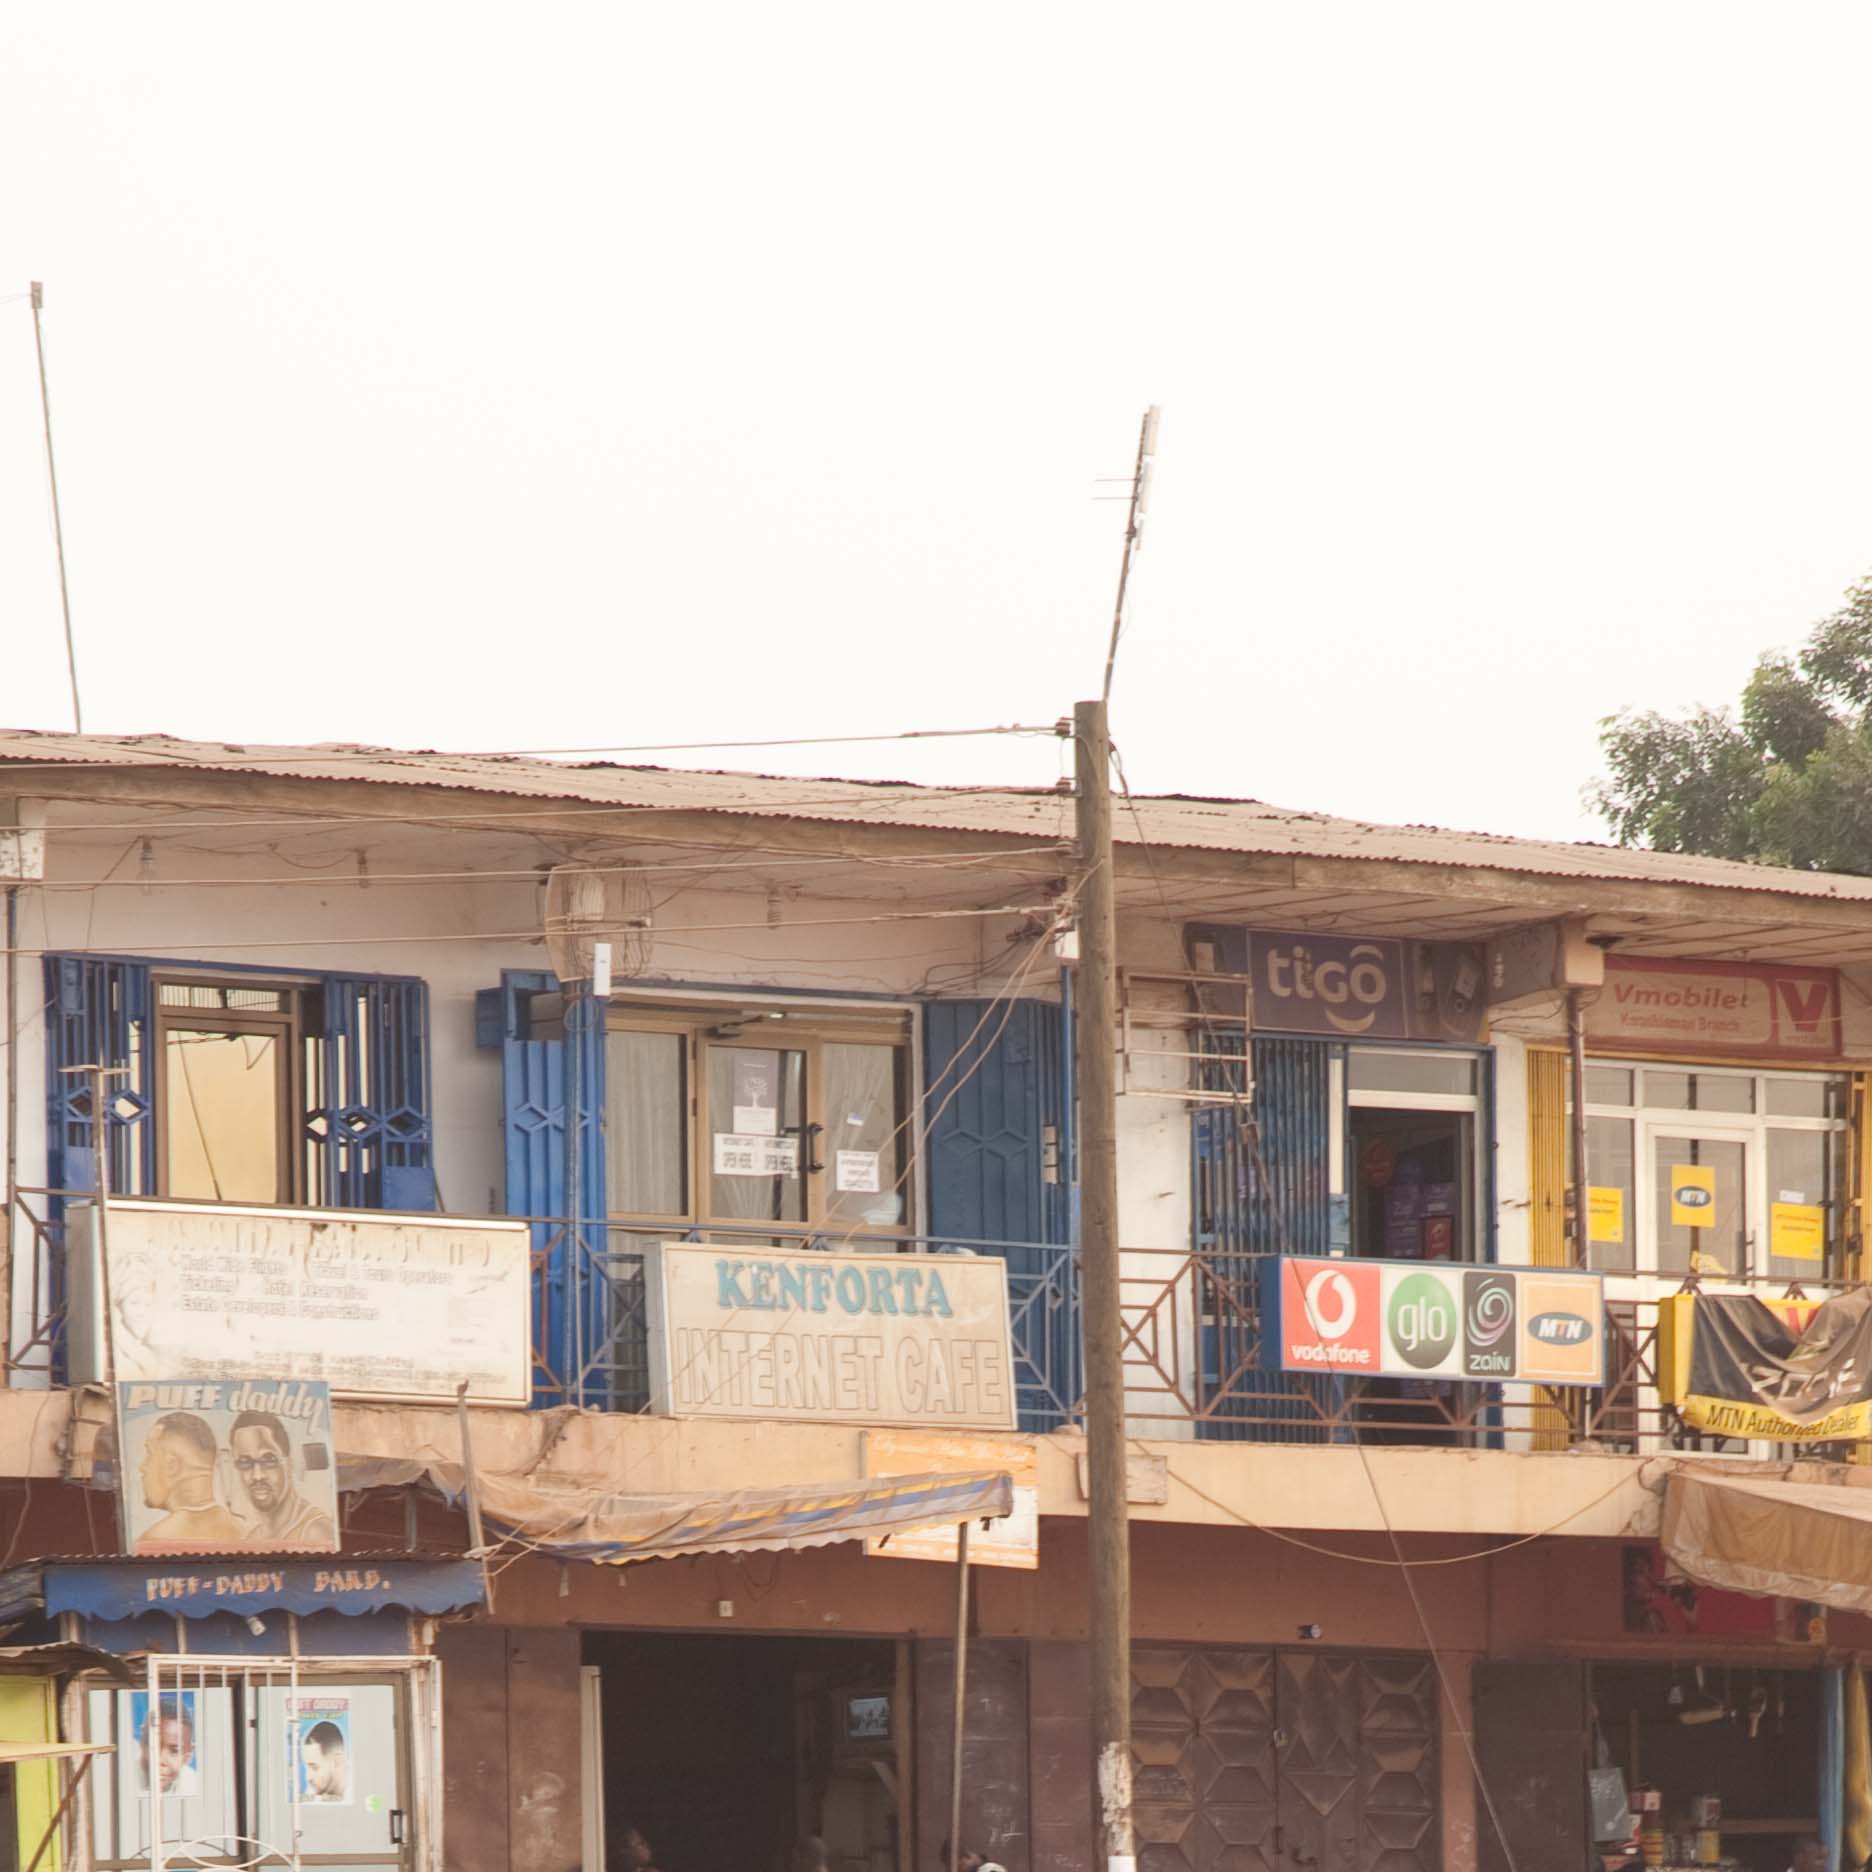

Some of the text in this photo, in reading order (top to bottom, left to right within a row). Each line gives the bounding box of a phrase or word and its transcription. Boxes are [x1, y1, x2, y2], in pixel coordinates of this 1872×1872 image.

[1267, 945, 1386, 1004] tigo
[1680, 1189, 1707, 1205] MTN
[716, 1259, 953, 1318] KENFORTA
[1397, 1296, 1447, 1351] glo
[1538, 1319, 1583, 1339] MTN
[677, 1328, 1003, 1415] INTERNET CAFE
[1292, 1344, 1370, 1365] vodafone
[1470, 1353, 1511, 1372] zain
[126, 1381, 324, 1436] PUFF daddy
[1707, 1405, 1744, 1427] MTN
